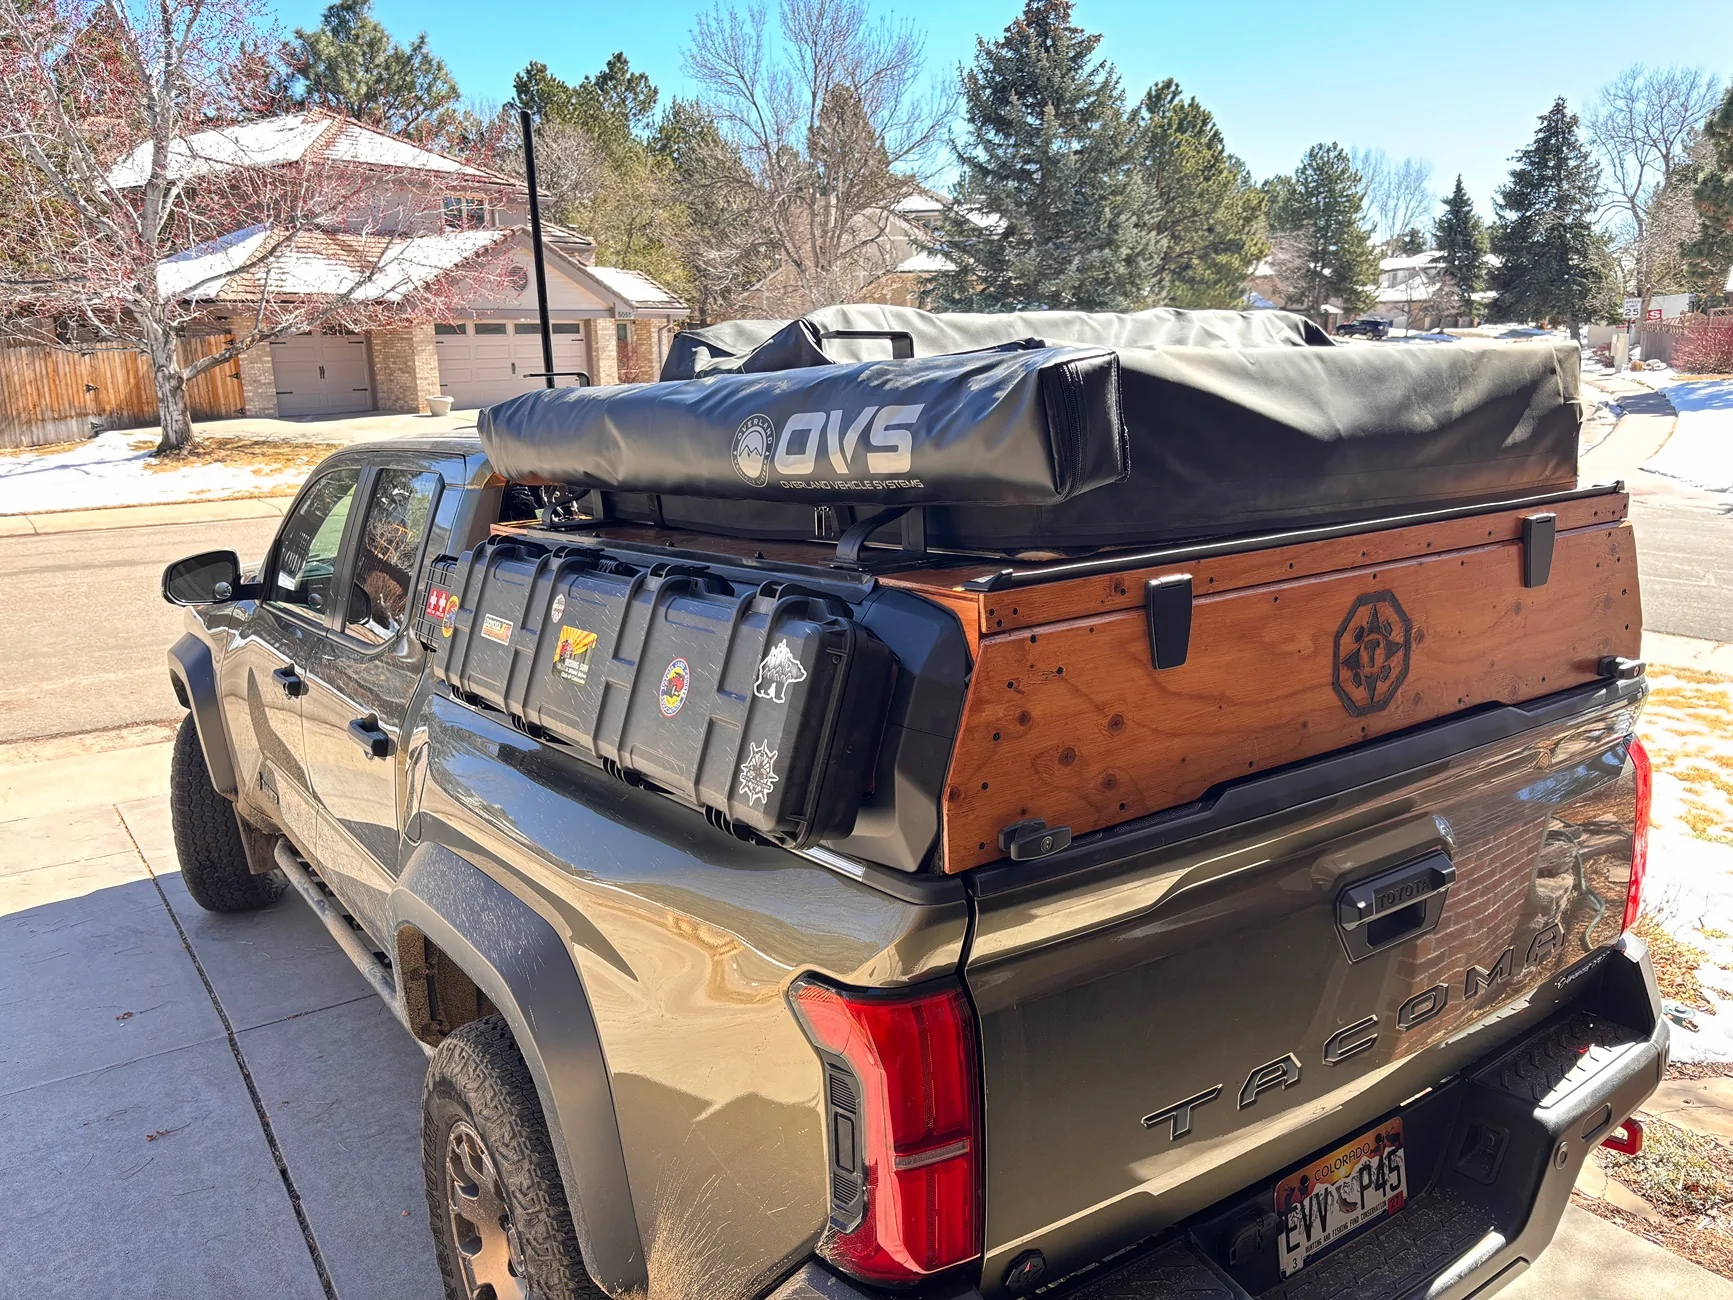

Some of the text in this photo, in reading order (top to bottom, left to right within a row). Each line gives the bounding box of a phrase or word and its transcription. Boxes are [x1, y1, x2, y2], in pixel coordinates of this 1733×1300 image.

[1624, 308, 1640, 316] 25
[737, 418, 773, 444] OVERLAND
[774, 403, 925, 475] OVS
[780, 479, 924, 490] OVERLAND VEHICLE SYSTEMS
[1377, 875, 1431, 909] TOYOTA
[1140, 921, 1566, 1141] TACOMA
[1314, 1142, 1370, 1181] COLORADO
[1359, 1149, 1401, 1211] P45
[1390, 1197, 1400, 1209] 27
[1305, 1200, 1387, 1254] HUNTING AND FISHING FUND CONSERVATION
[1292, 1258, 1298, 1269] 3
